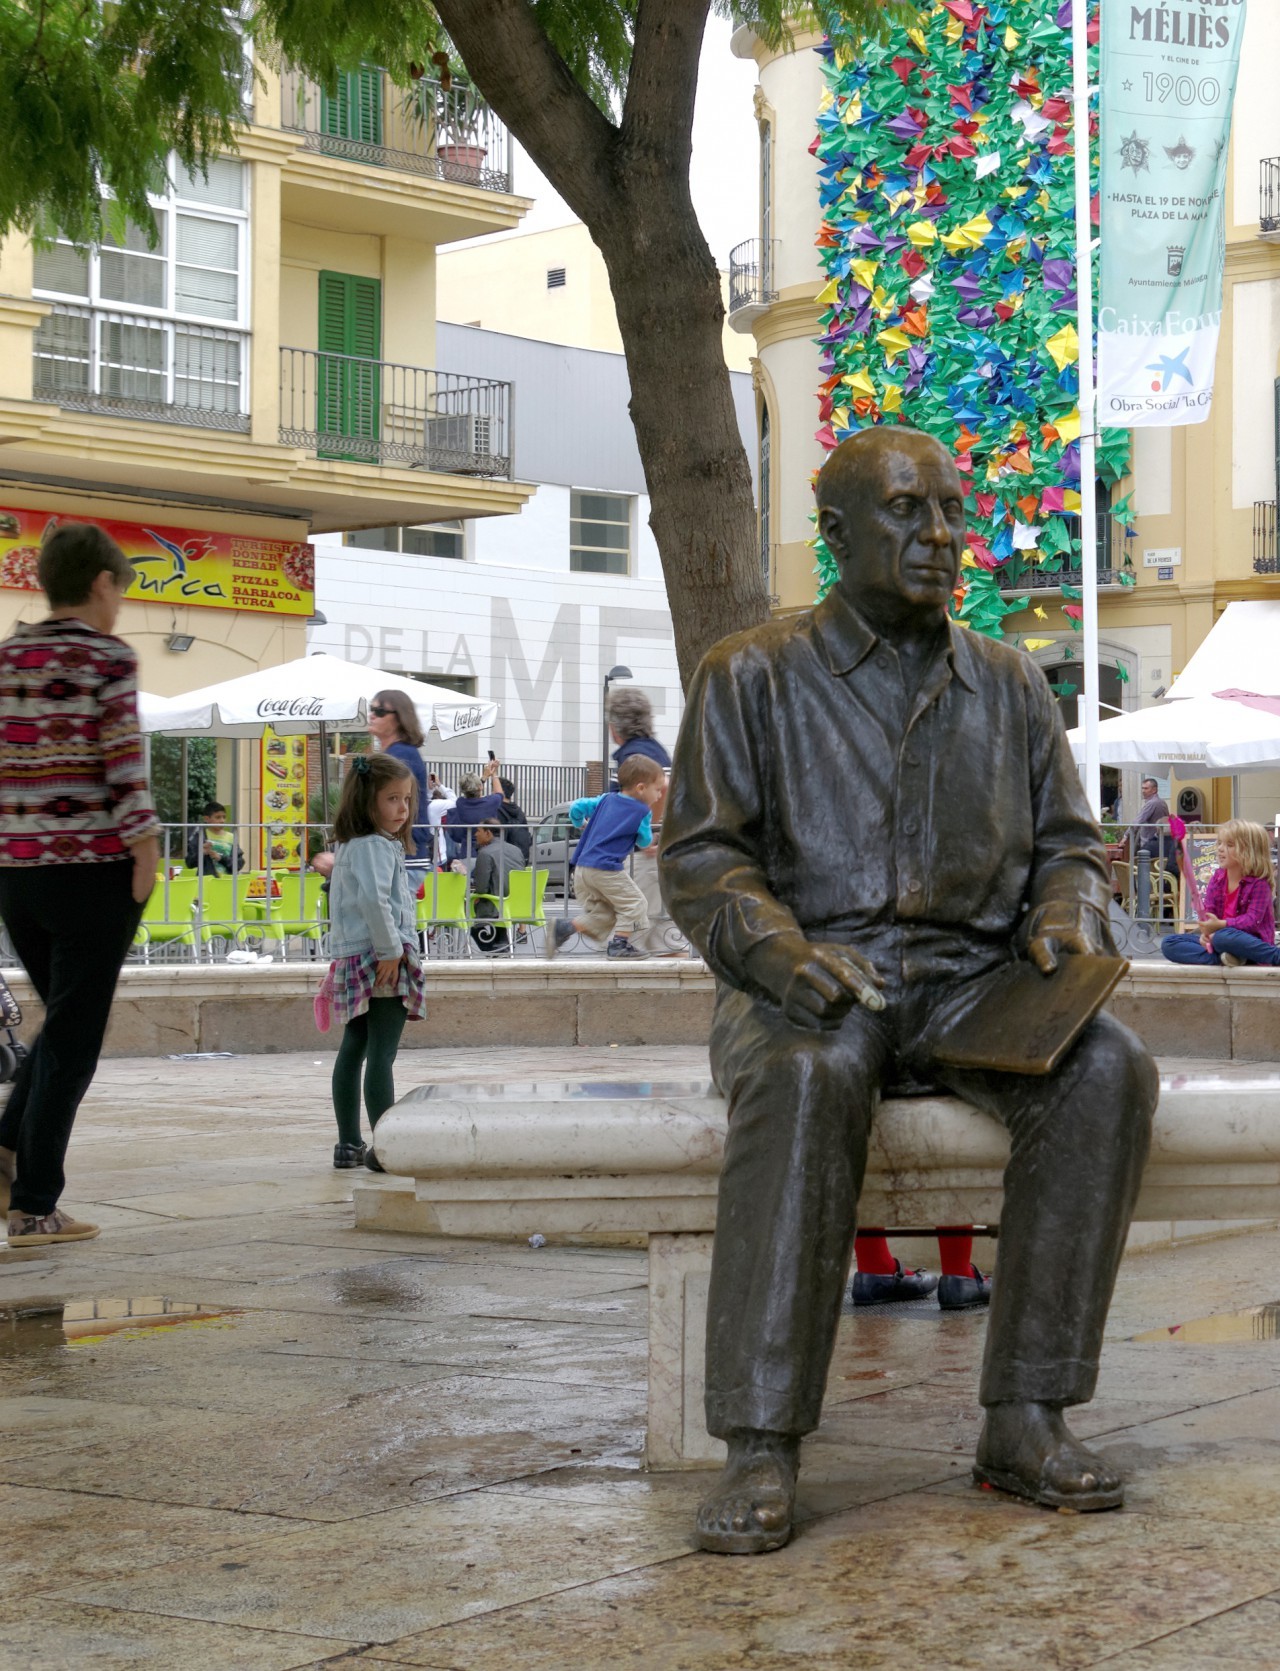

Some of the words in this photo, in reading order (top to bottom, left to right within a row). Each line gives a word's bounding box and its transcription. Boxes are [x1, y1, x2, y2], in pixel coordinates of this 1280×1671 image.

[1129, 1, 1230, 49] MÉLIÈS
[1167, 55, 1174, 63] EL
[1143, 71, 1220, 106] 1900
[1112, 193, 1142, 205] HASTA
[1145, 196, 1156, 206] EL
[1159, 196, 1169, 206] 19
[1172, 197, 1185, 206] DE
[1131, 208, 1160, 220] PLAZA
[1162, 211, 1175, 220] DE
[1178, 211, 1189, 220] LA
[1110, 397, 1143, 412] Obra
[1145, 397, 1180, 411] Social
[232, 538, 292, 553] TURKISH
[232, 549, 278, 562] DONER
[232, 559, 277, 571] KEBAB
[232, 574, 279, 587] PIZZAS
[232, 586, 301, 602] BARBACOA
[232, 596, 275, 608] TURCA
[345, 624, 404, 672] DE
[422, 630, 477, 676] LA
